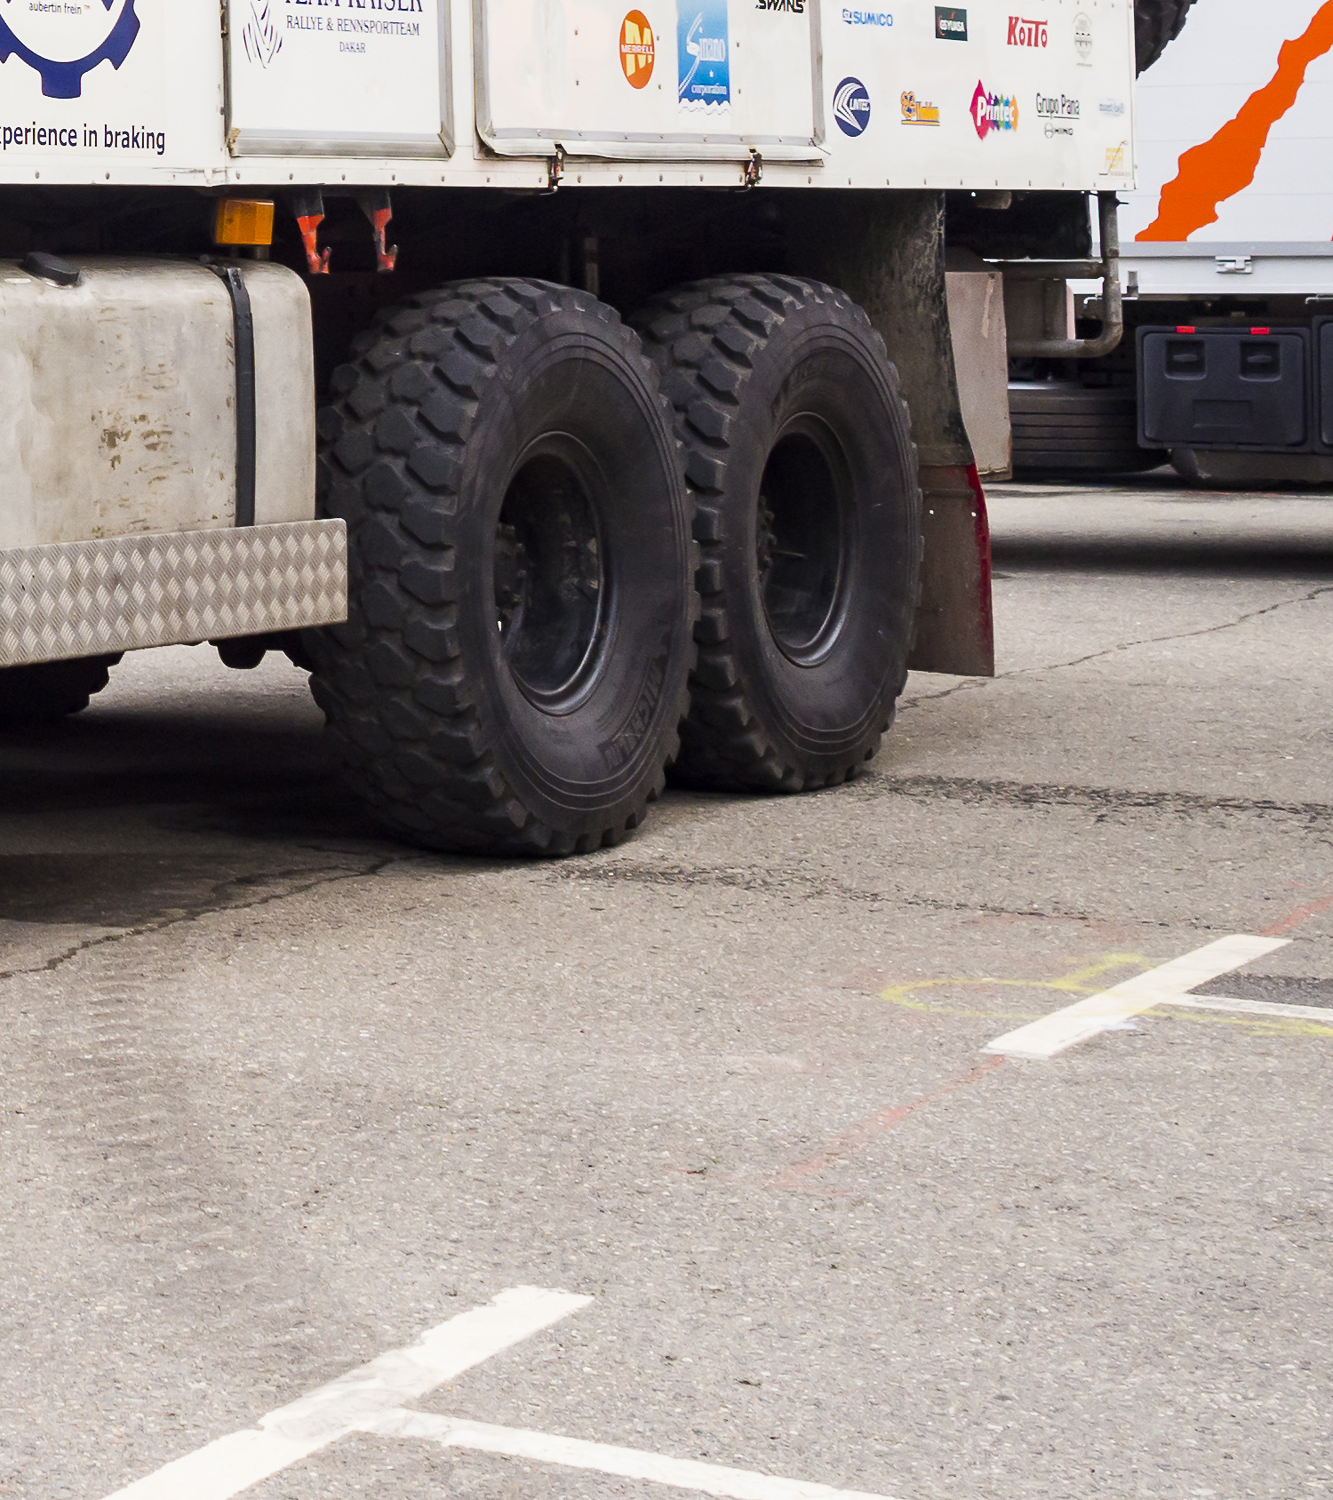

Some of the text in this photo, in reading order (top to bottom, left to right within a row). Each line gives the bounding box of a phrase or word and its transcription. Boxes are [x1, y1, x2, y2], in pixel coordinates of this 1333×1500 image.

[28, 0, 83, 15] aubertin frein
[286, 15, 420, 36] RALLYE & RENNSPORTTEAM
[853, 10, 893, 27] SUMICO
[339, 41, 366, 54] DAKAR
[621, 44, 655, 55] MERRELL
[1035, 92, 1060, 118] Grupo
[82, 123, 98, 148] in
[103, 124, 166, 156] braking
